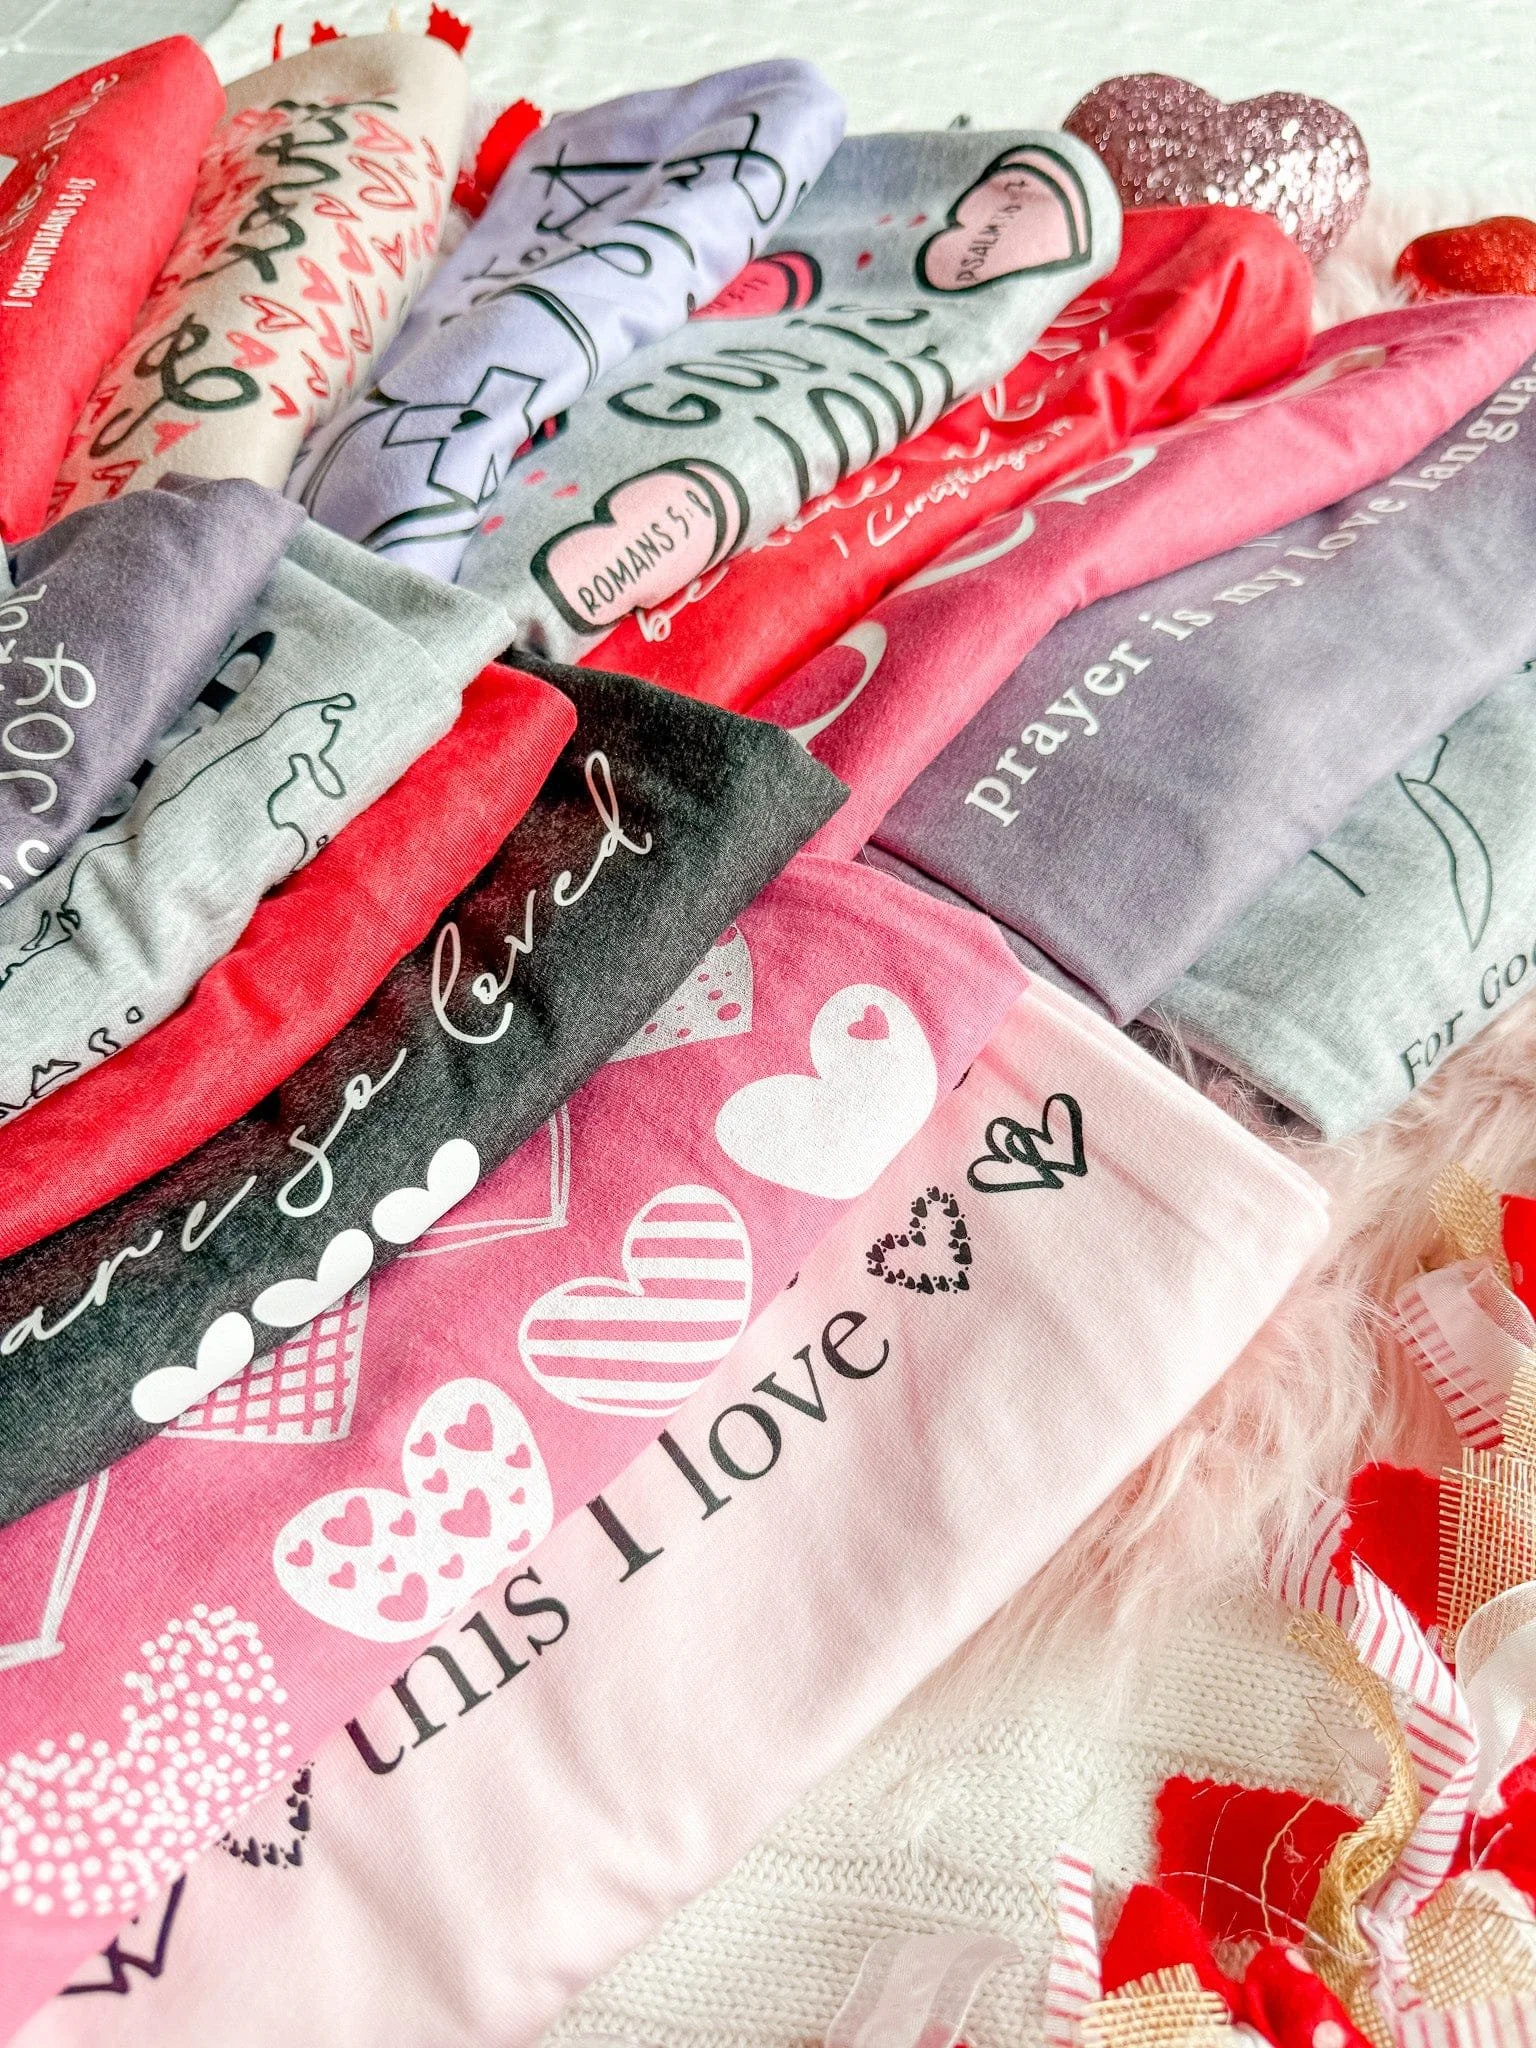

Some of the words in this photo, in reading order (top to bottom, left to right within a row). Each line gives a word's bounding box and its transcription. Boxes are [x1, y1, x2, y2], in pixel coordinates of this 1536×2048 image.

[8, 208, 78, 298] CORINTHIANS
[56, 177, 97, 207] 13:13
[578, 523, 675, 616] ROMANS
[964, 638, 1153, 827] prayer
[1138, 607, 1216, 641] is
[1212, 565, 1306, 606] my
[1283, 496, 1407, 561] love
[1388, 360, 1536, 492] langua
[1, 1175, 258, 1356] are
[275, 1048, 407, 1217] so
[430, 751, 653, 1045] loved
[1400, 1011, 1464, 1092] For
[1479, 938, 1536, 1011] Go
[586, 1495, 665, 1584] I
[657, 1310, 890, 1521] love
